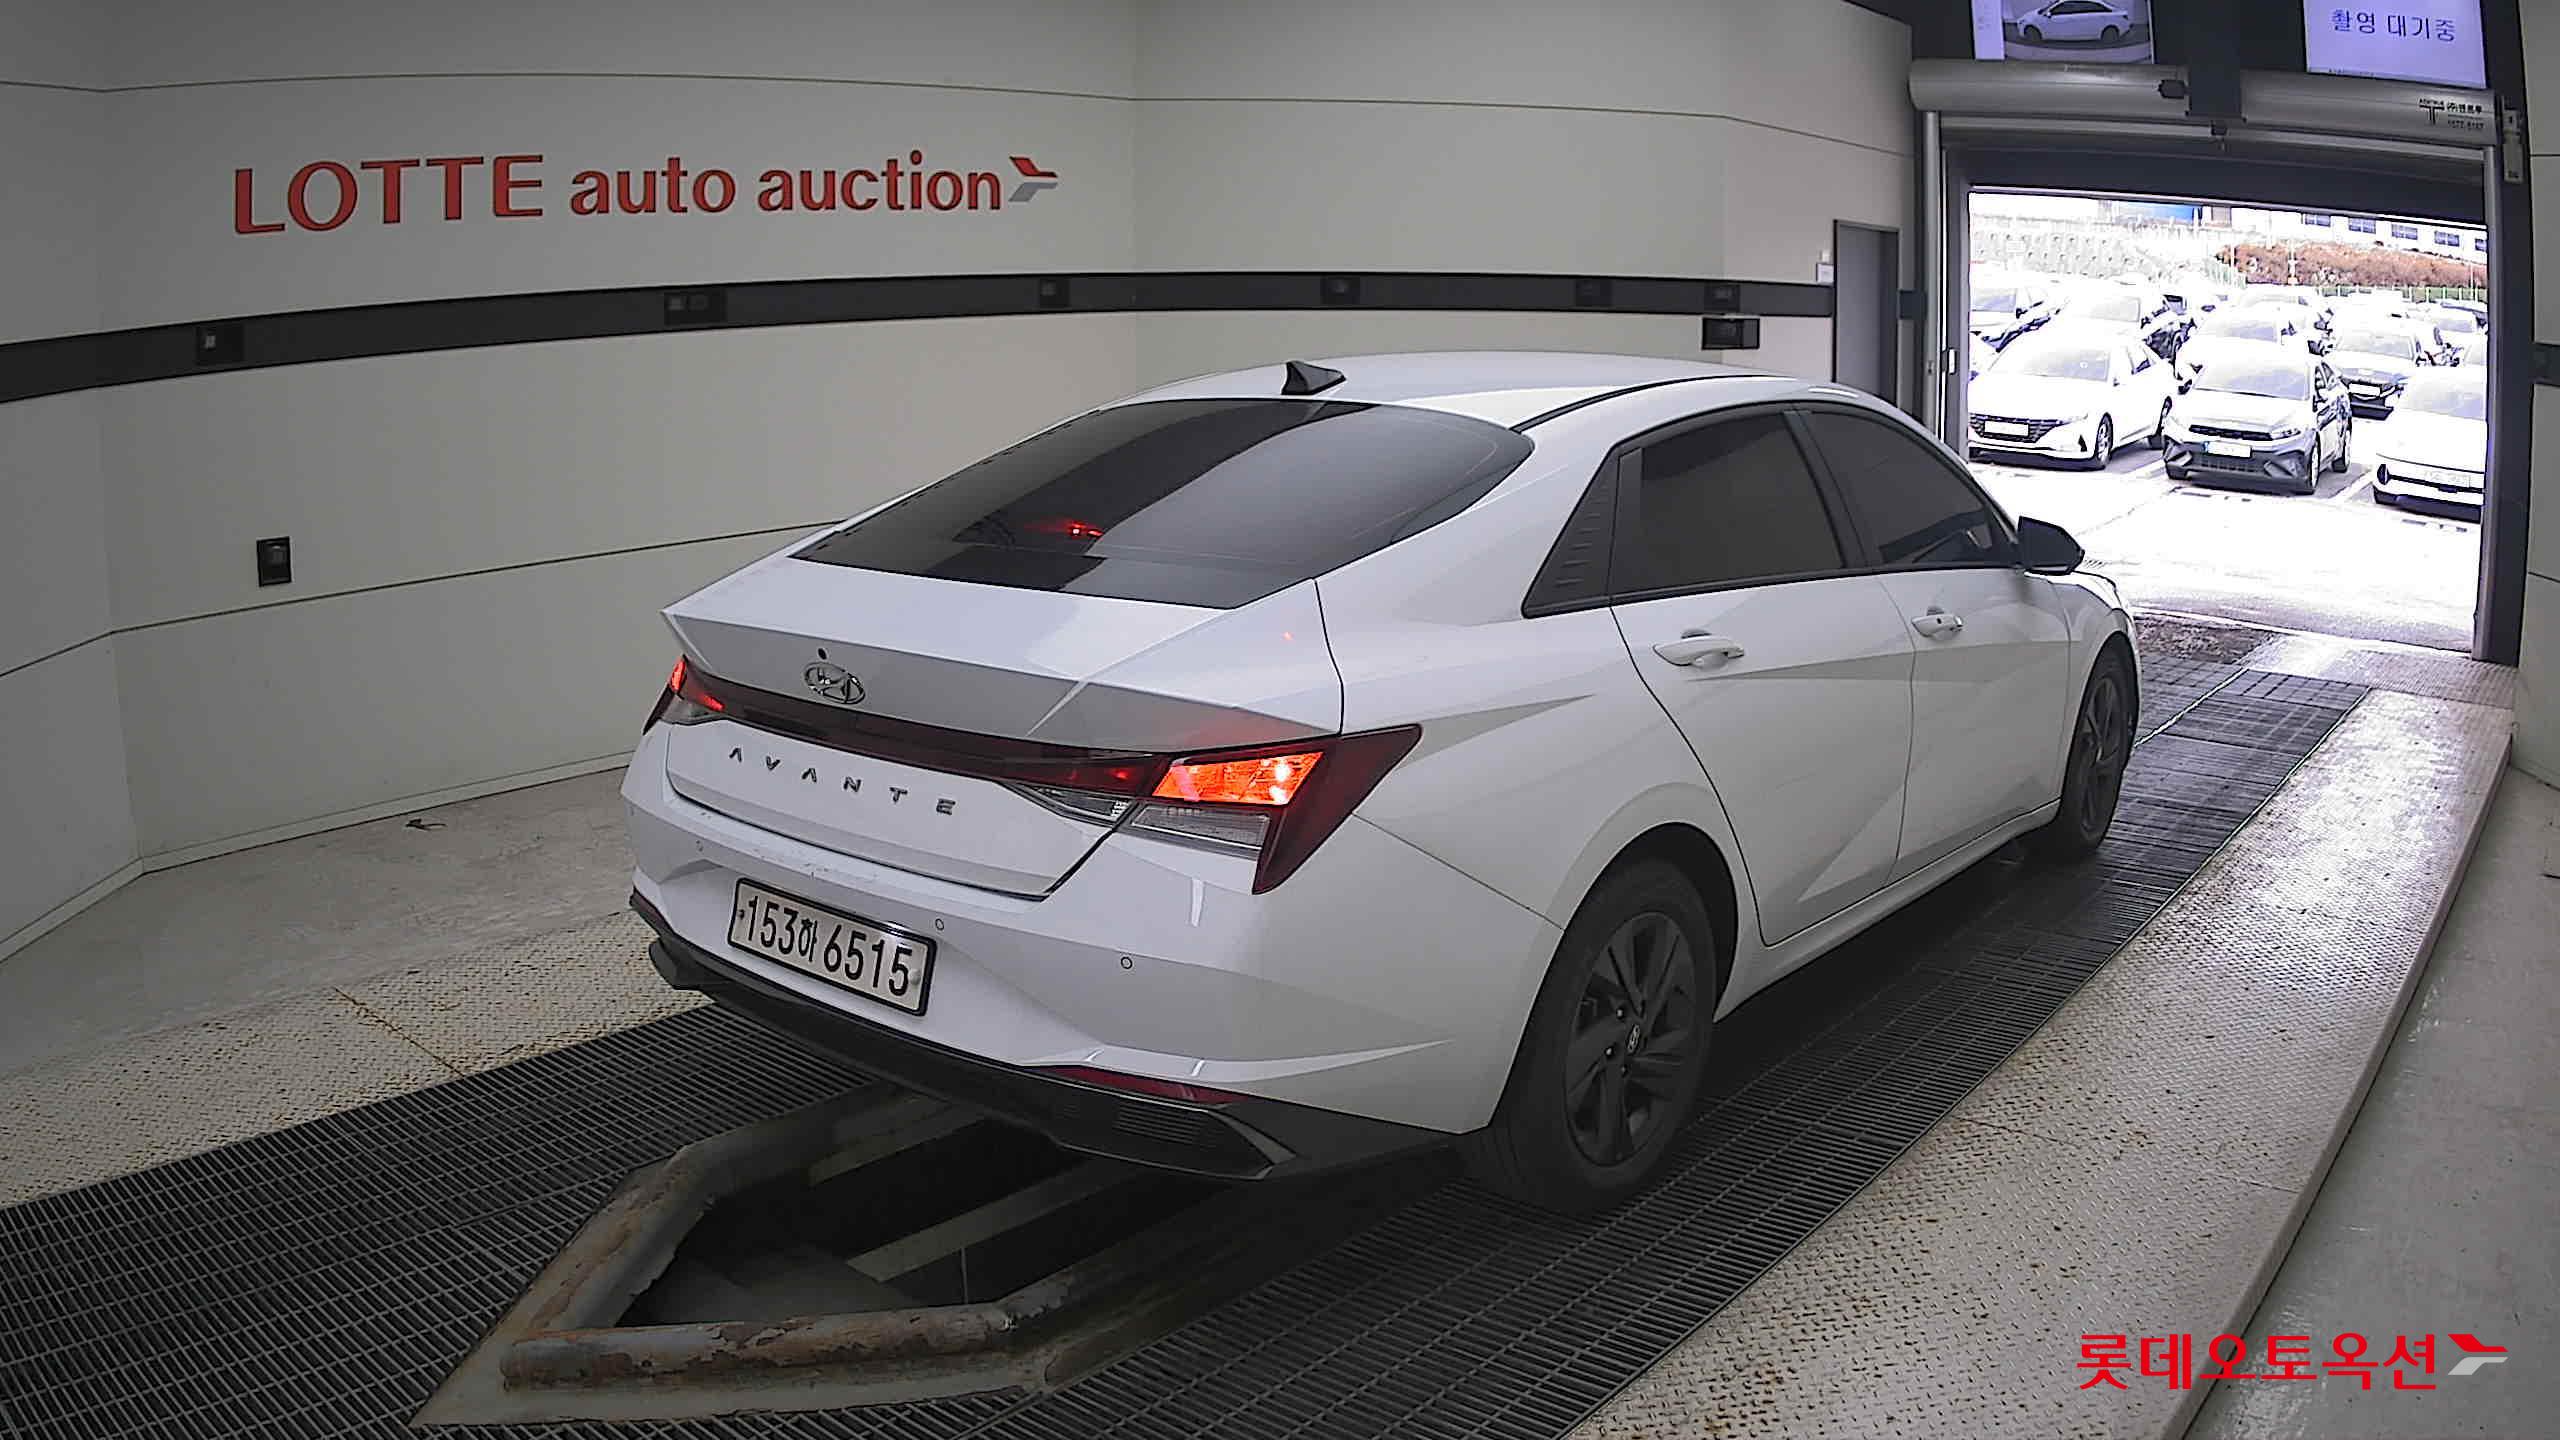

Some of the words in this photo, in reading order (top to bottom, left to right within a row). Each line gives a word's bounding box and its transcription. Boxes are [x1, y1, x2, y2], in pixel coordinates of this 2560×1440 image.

[2331, 9, 2376, 35] 촬영
[2387, 14, 2456, 43] 대기중
[235, 154, 543, 234] LOTTE
[570, 157, 737, 215] auto
[758, 150, 1001, 211] auction
[728, 746, 956, 815] AVANTE
[748, 895, 818, 963] 153하
[823, 924, 914, 997] 6515
